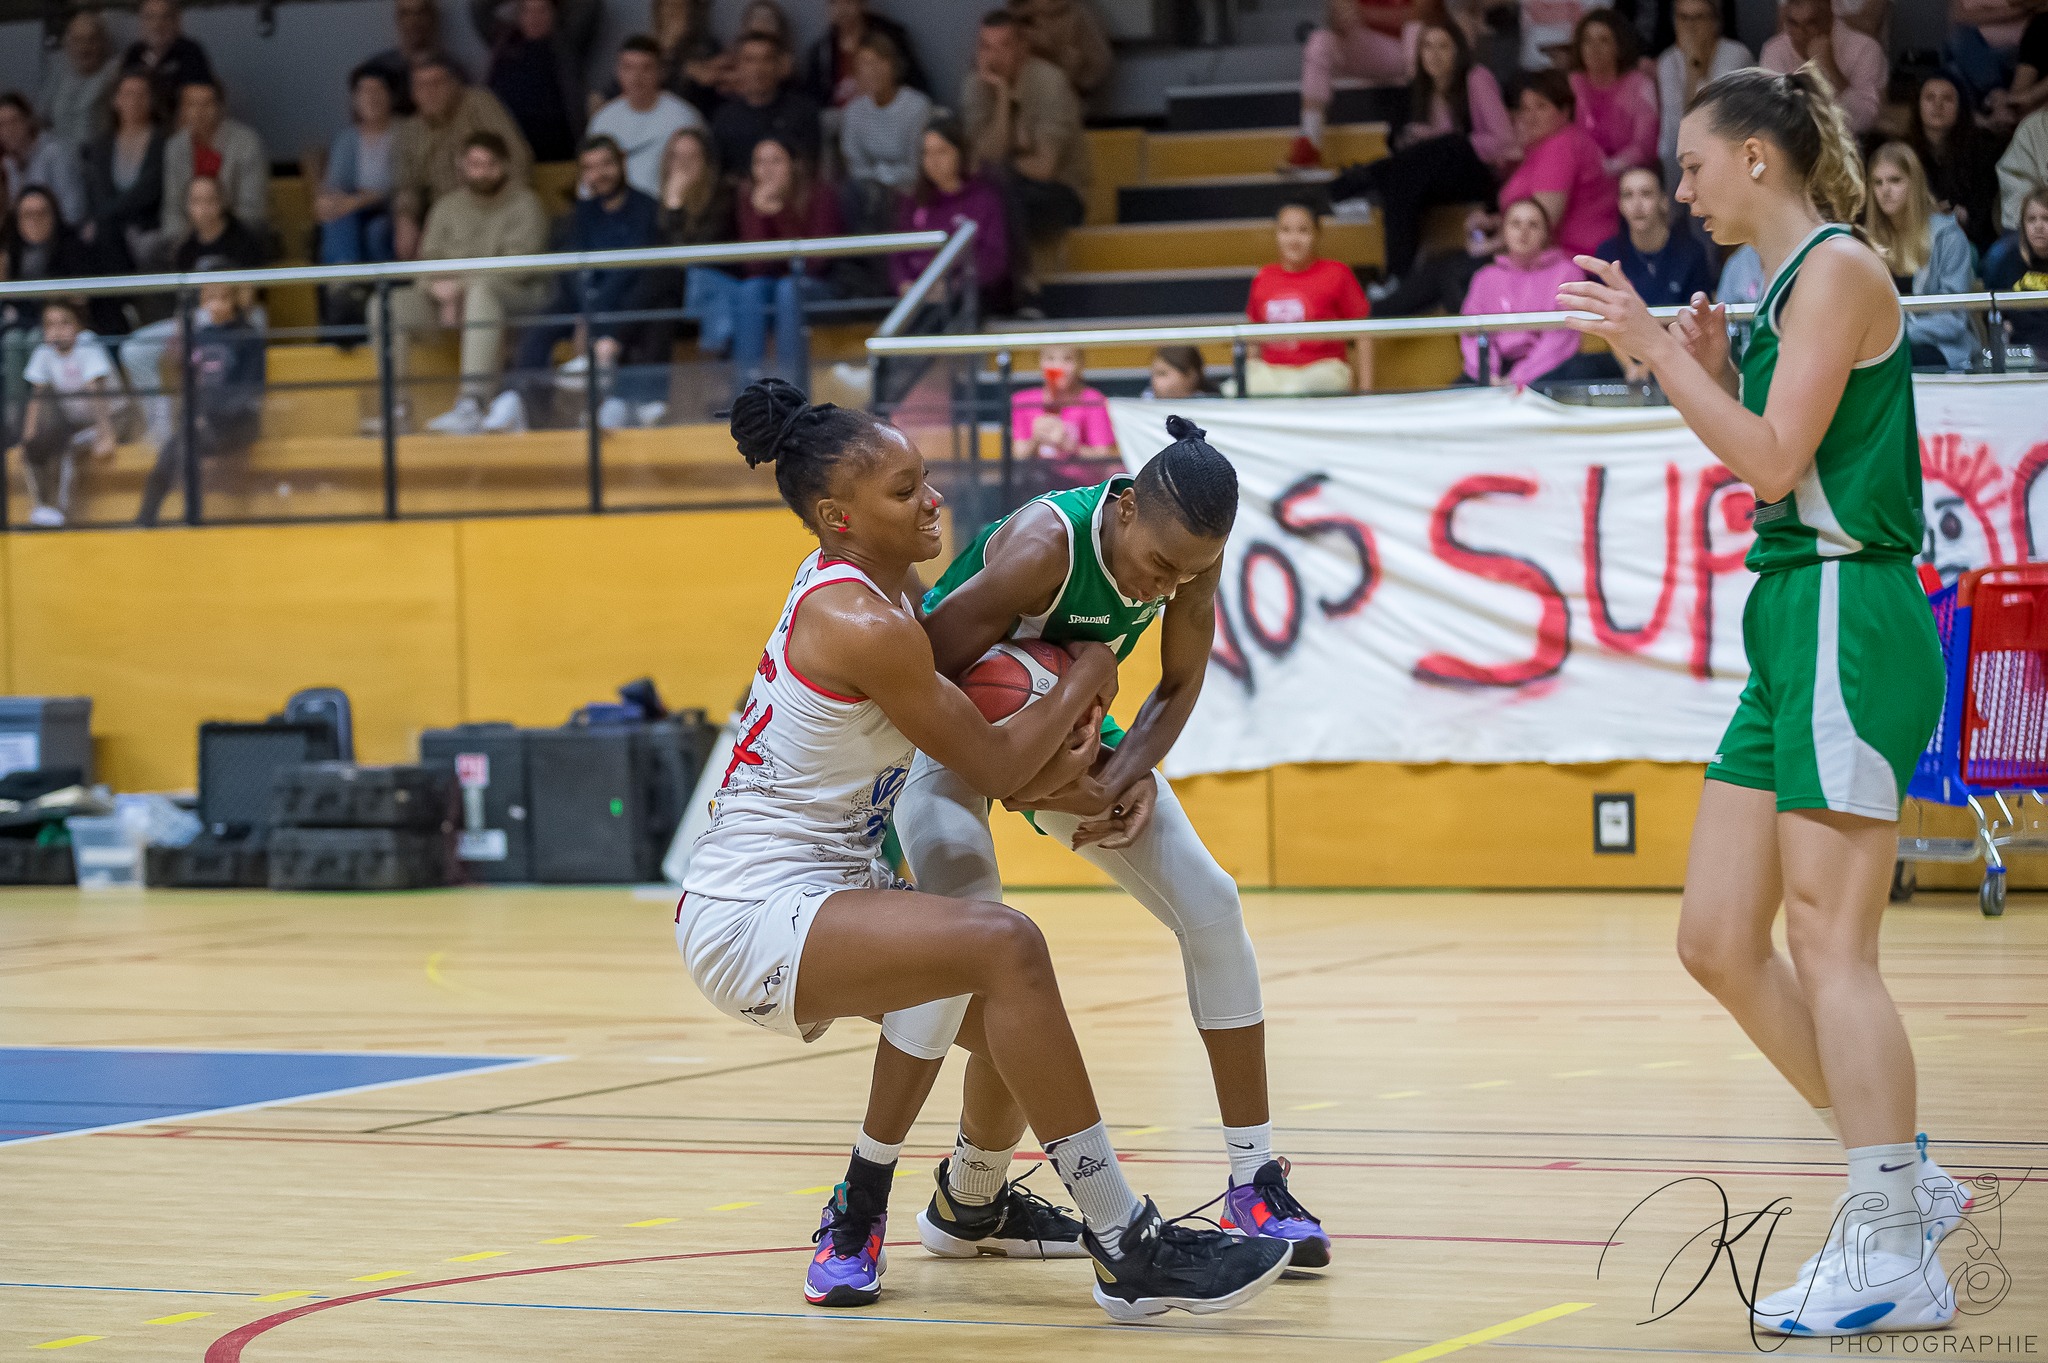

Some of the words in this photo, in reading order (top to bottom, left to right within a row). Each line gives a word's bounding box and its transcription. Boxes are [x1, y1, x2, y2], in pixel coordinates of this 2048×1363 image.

[1413, 463, 1757, 687] SUP
[1068, 614, 1111, 625] SPALDING
[1073, 1158, 1109, 1181] PEAK
